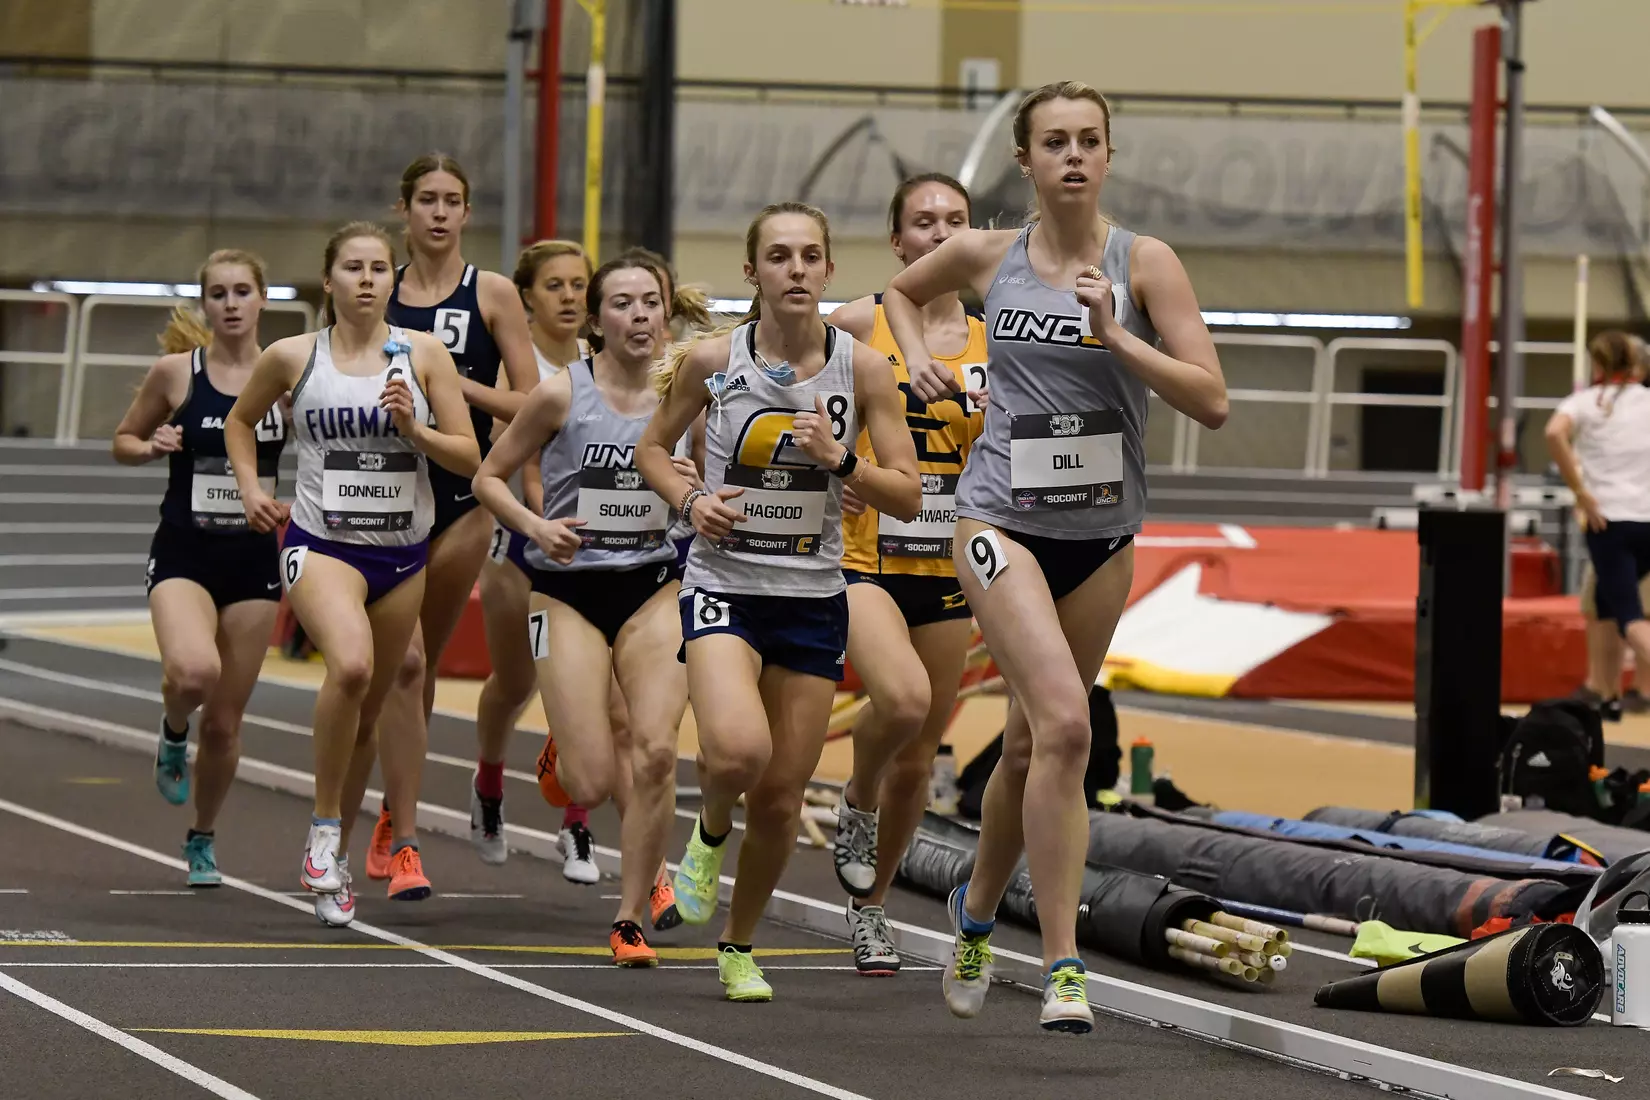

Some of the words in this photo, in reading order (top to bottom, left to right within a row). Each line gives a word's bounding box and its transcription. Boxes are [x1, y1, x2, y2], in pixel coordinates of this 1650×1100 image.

[1007, 275, 1026, 285] asics
[442, 311, 462, 349] 5
[725, 383, 751, 392] adidas
[262, 407, 279, 438] 4
[305, 406, 416, 442] FURMA
[826, 394, 848, 441] 8
[1052, 453, 1084, 470] DILL
[338, 484, 402, 499] DONNELLY
[1043, 492, 1088, 504] #SOCONTF
[599, 503, 651, 517] SOUKUP
[743, 502, 803, 520] HAGOOD
[347, 516, 385, 526] #SOCONTF
[601, 536, 638, 545] #SOCONTF
[745, 538, 788, 549] #SOCONTF
[904, 543, 941, 552] #SOCONTF
[286, 548, 300, 585] 6
[971, 535, 996, 581] 9
[531, 614, 543, 658] 7
[1616, 943, 1626, 1014] ADVOCARE
